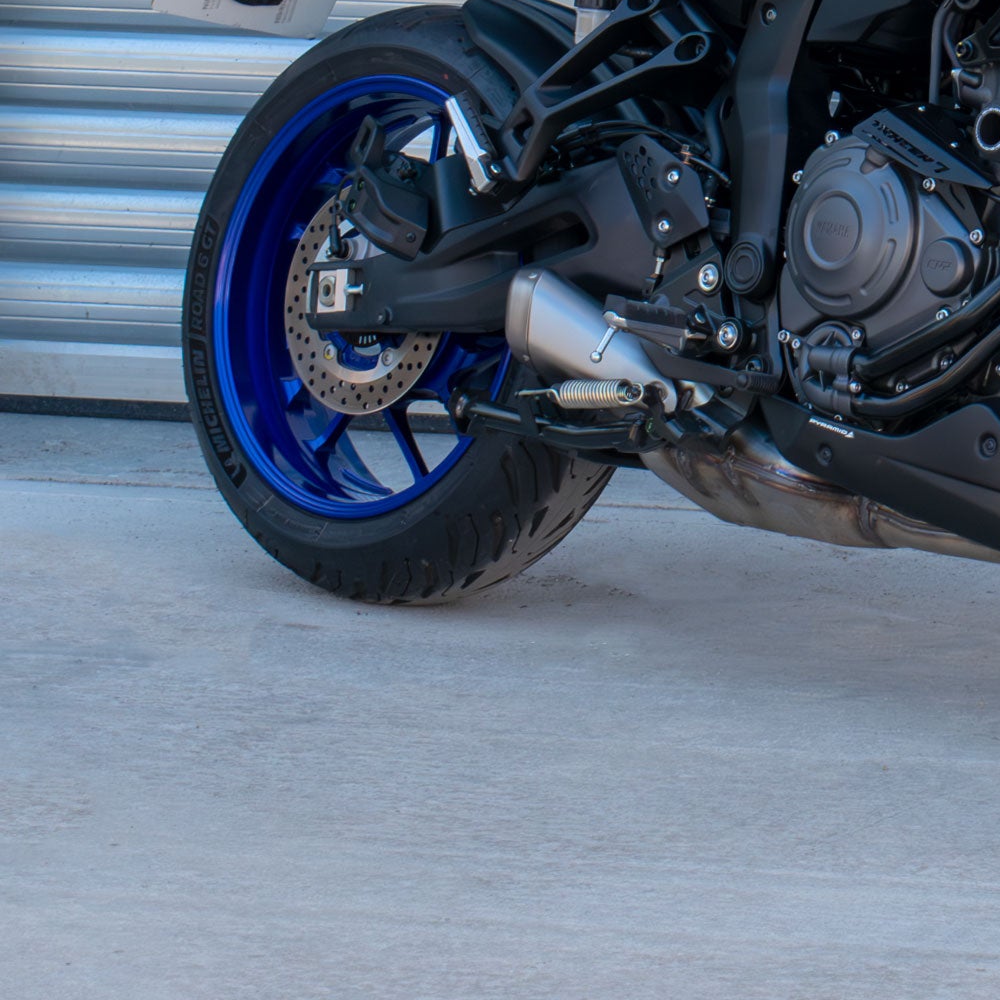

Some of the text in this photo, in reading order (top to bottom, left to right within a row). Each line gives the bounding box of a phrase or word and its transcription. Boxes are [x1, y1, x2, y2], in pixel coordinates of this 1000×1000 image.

[190, 220, 233, 455] MICHELIN ROAD 6 GT
[808, 417, 848, 435] PYRAMID
